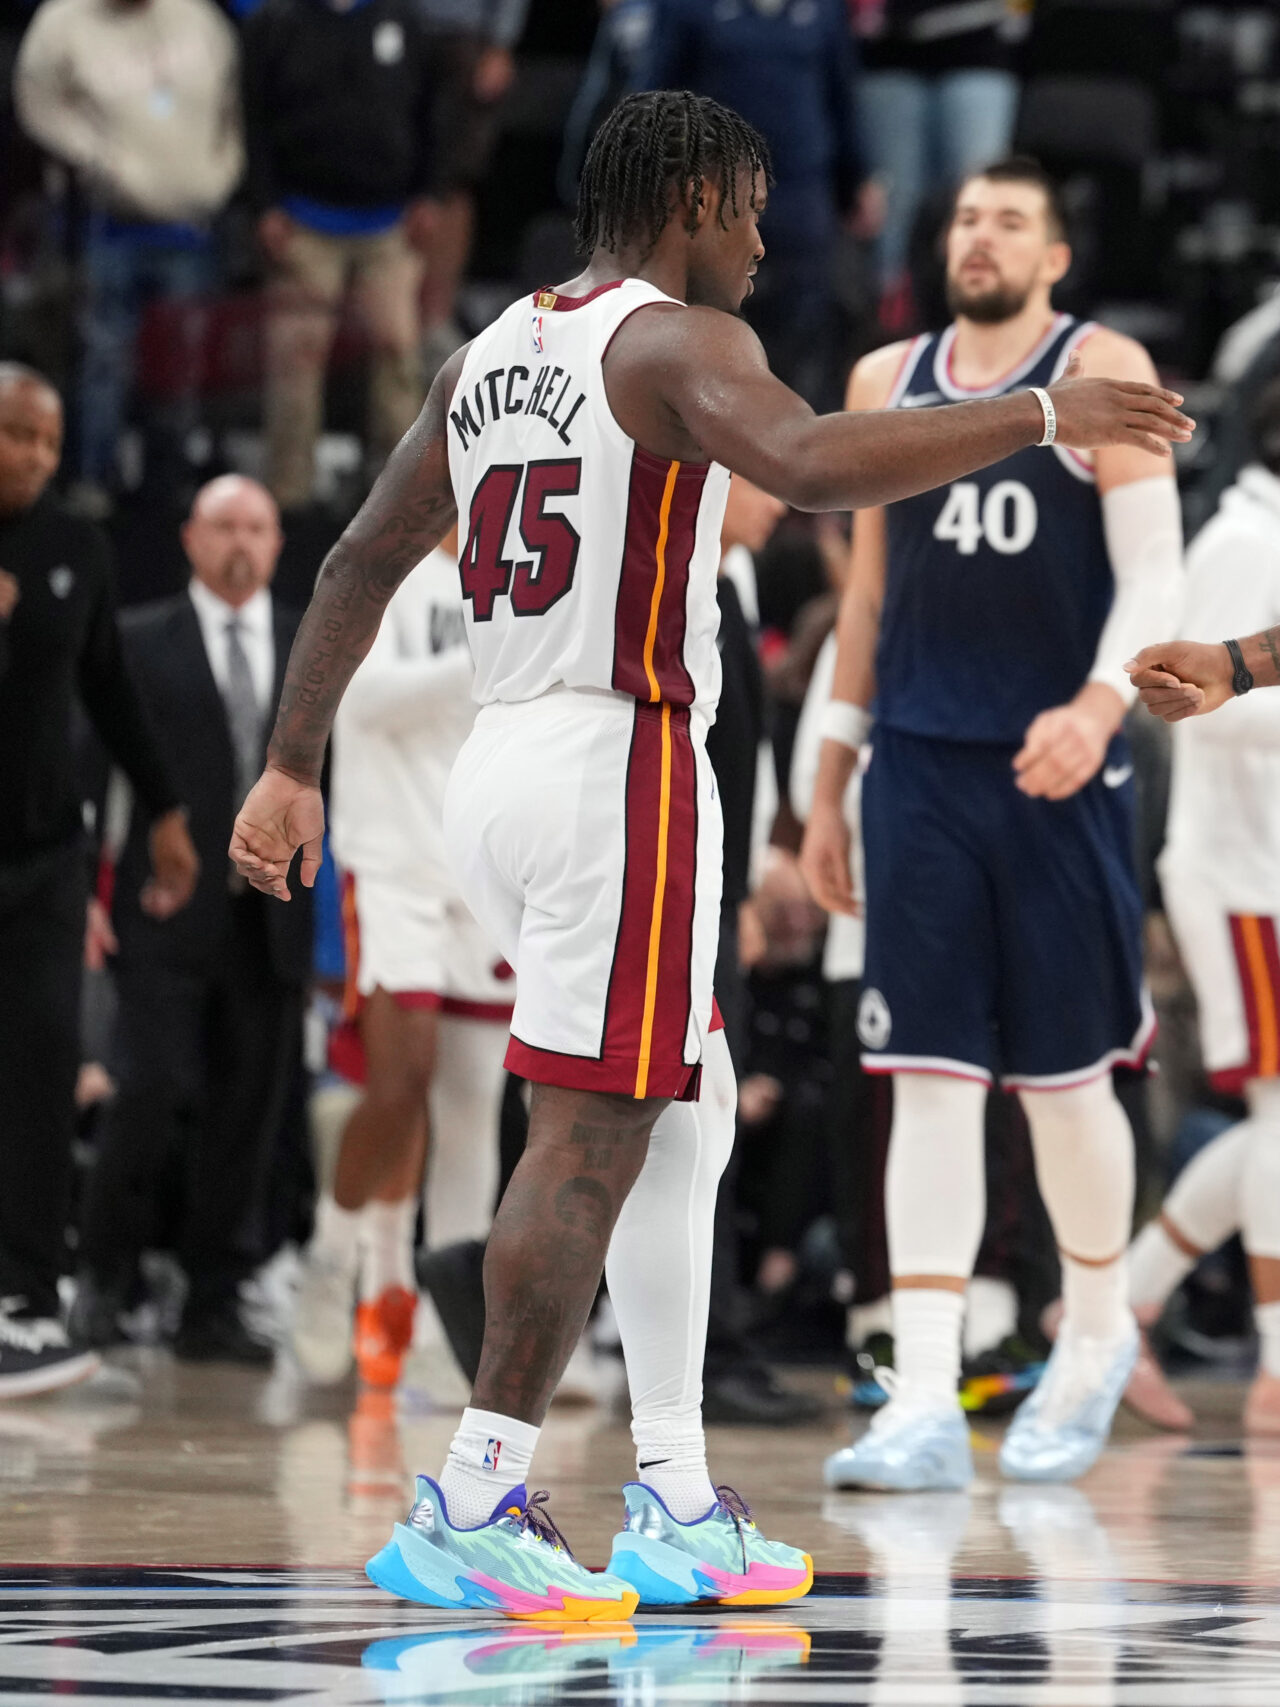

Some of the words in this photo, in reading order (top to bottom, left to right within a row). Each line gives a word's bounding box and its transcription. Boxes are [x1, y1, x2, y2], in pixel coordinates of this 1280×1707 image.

[450, 365, 587, 452] MITCHELL
[458, 457, 582, 623] 45
[932, 479, 1039, 555] 40
